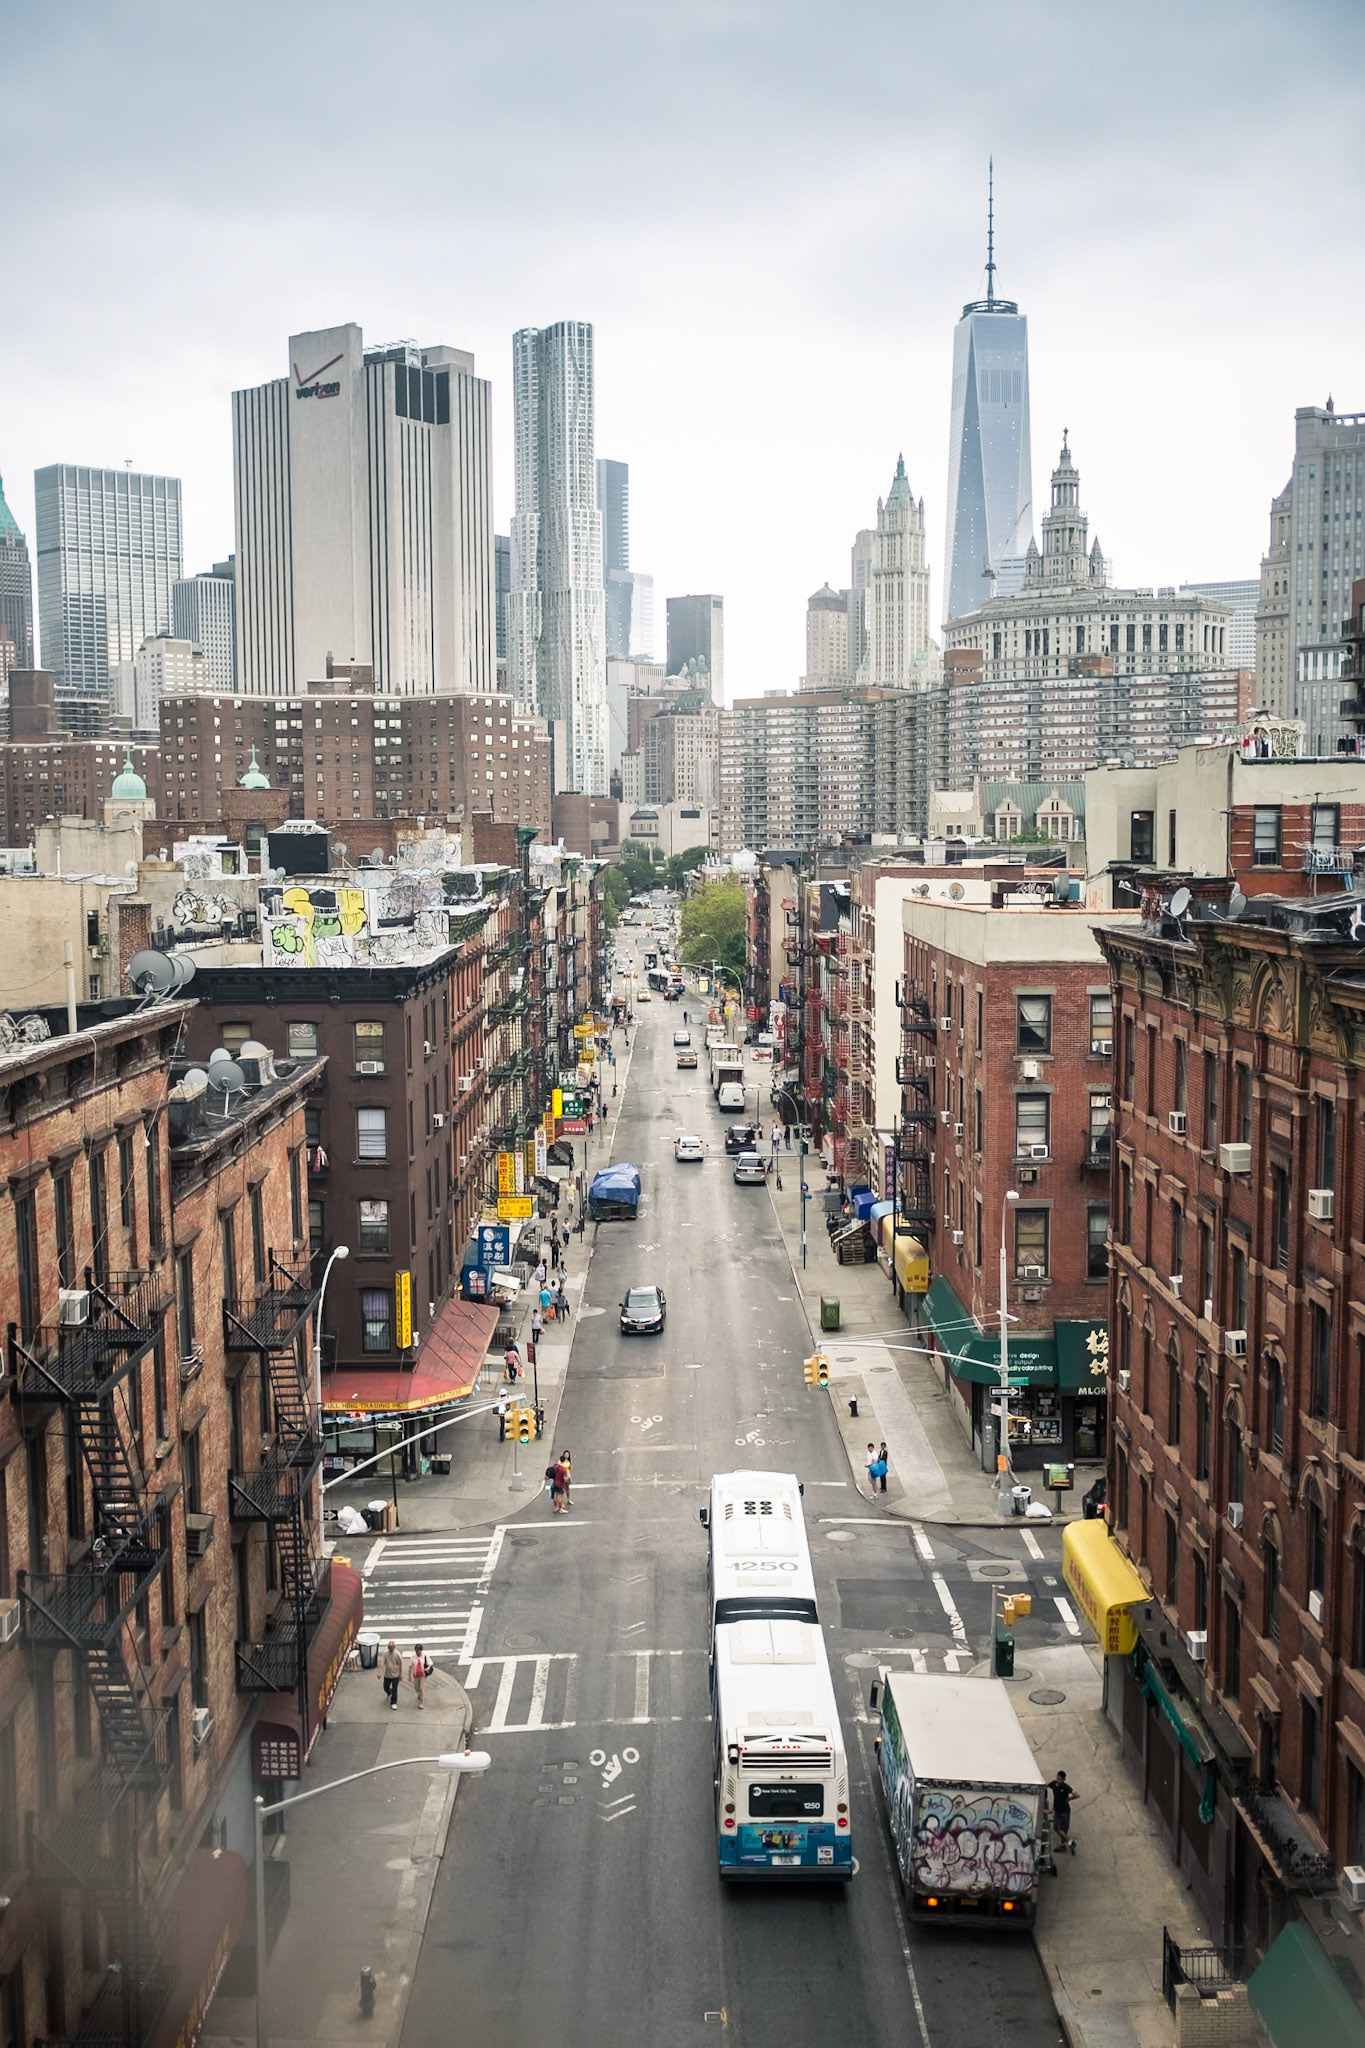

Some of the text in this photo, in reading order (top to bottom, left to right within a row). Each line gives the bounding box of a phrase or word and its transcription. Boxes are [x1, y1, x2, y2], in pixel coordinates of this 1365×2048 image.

[296, 382, 340, 399] verizon
[732, 1561, 799, 1571] 1250
[803, 1802, 821, 1810] 1250
